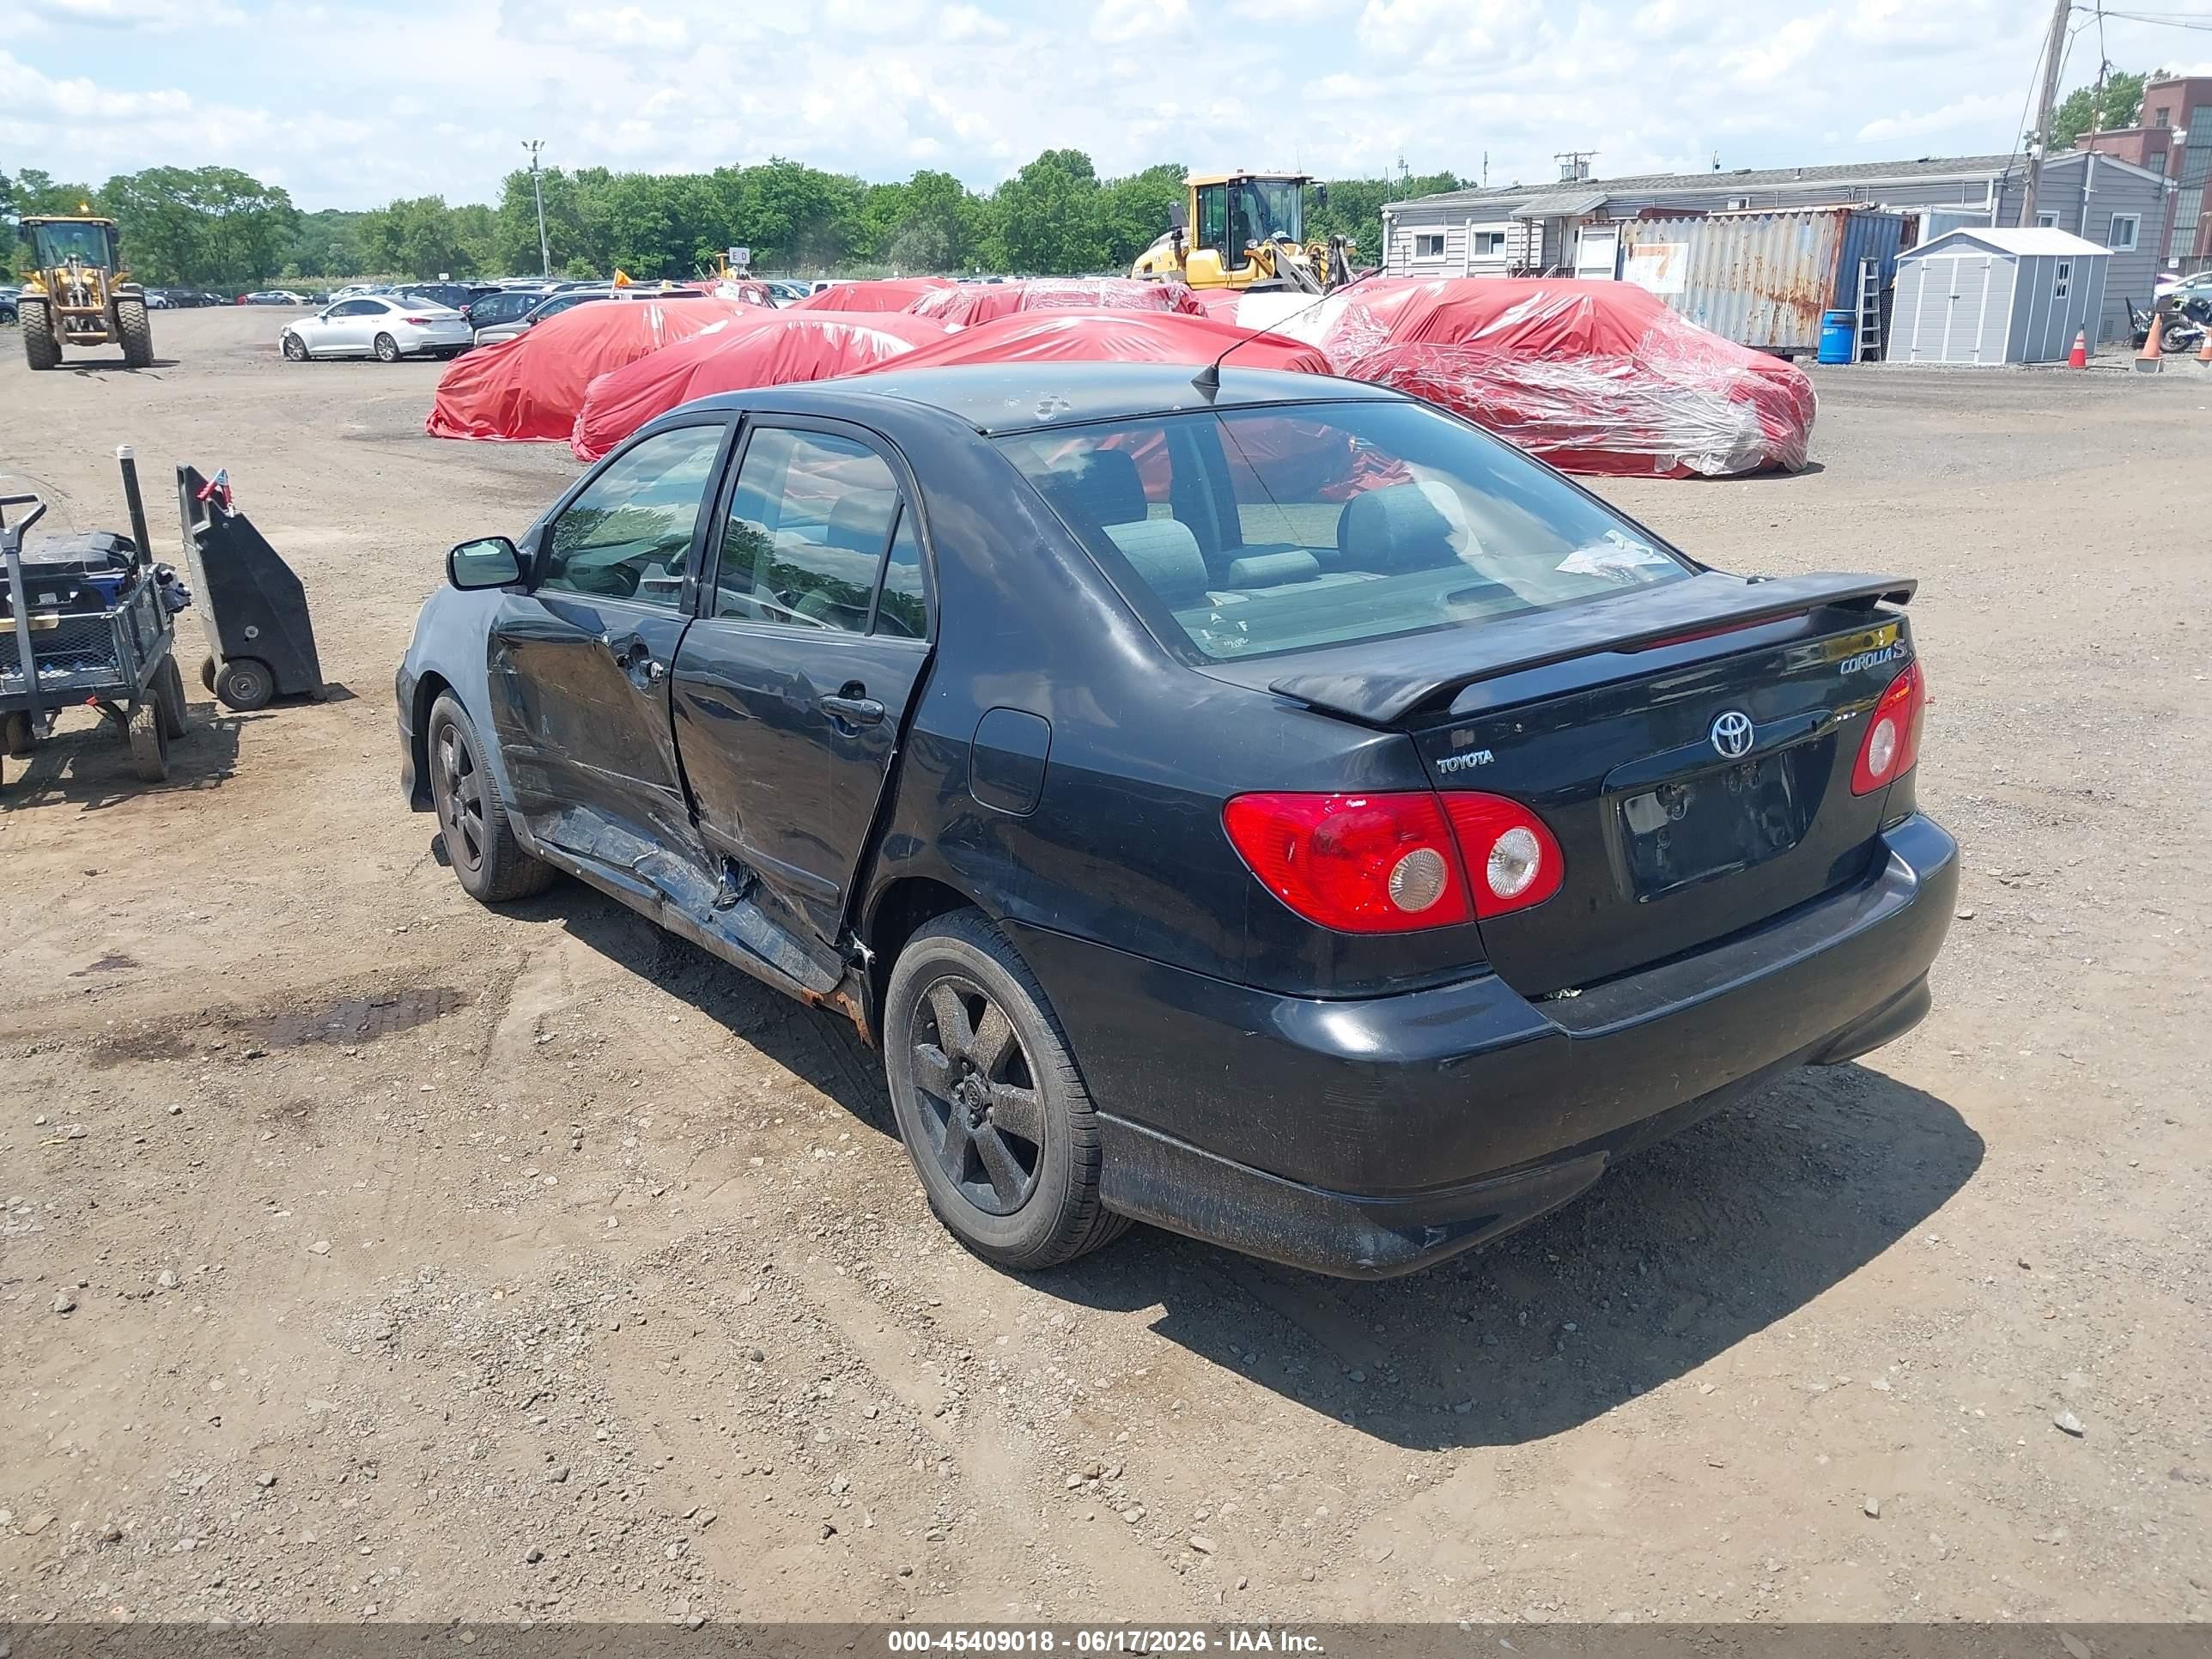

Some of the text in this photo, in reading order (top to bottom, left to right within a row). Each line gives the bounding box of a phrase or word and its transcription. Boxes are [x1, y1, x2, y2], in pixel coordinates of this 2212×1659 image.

[1840, 639, 1907, 675] COROLLA S
[1437, 750, 1495, 774] TOYOTA
